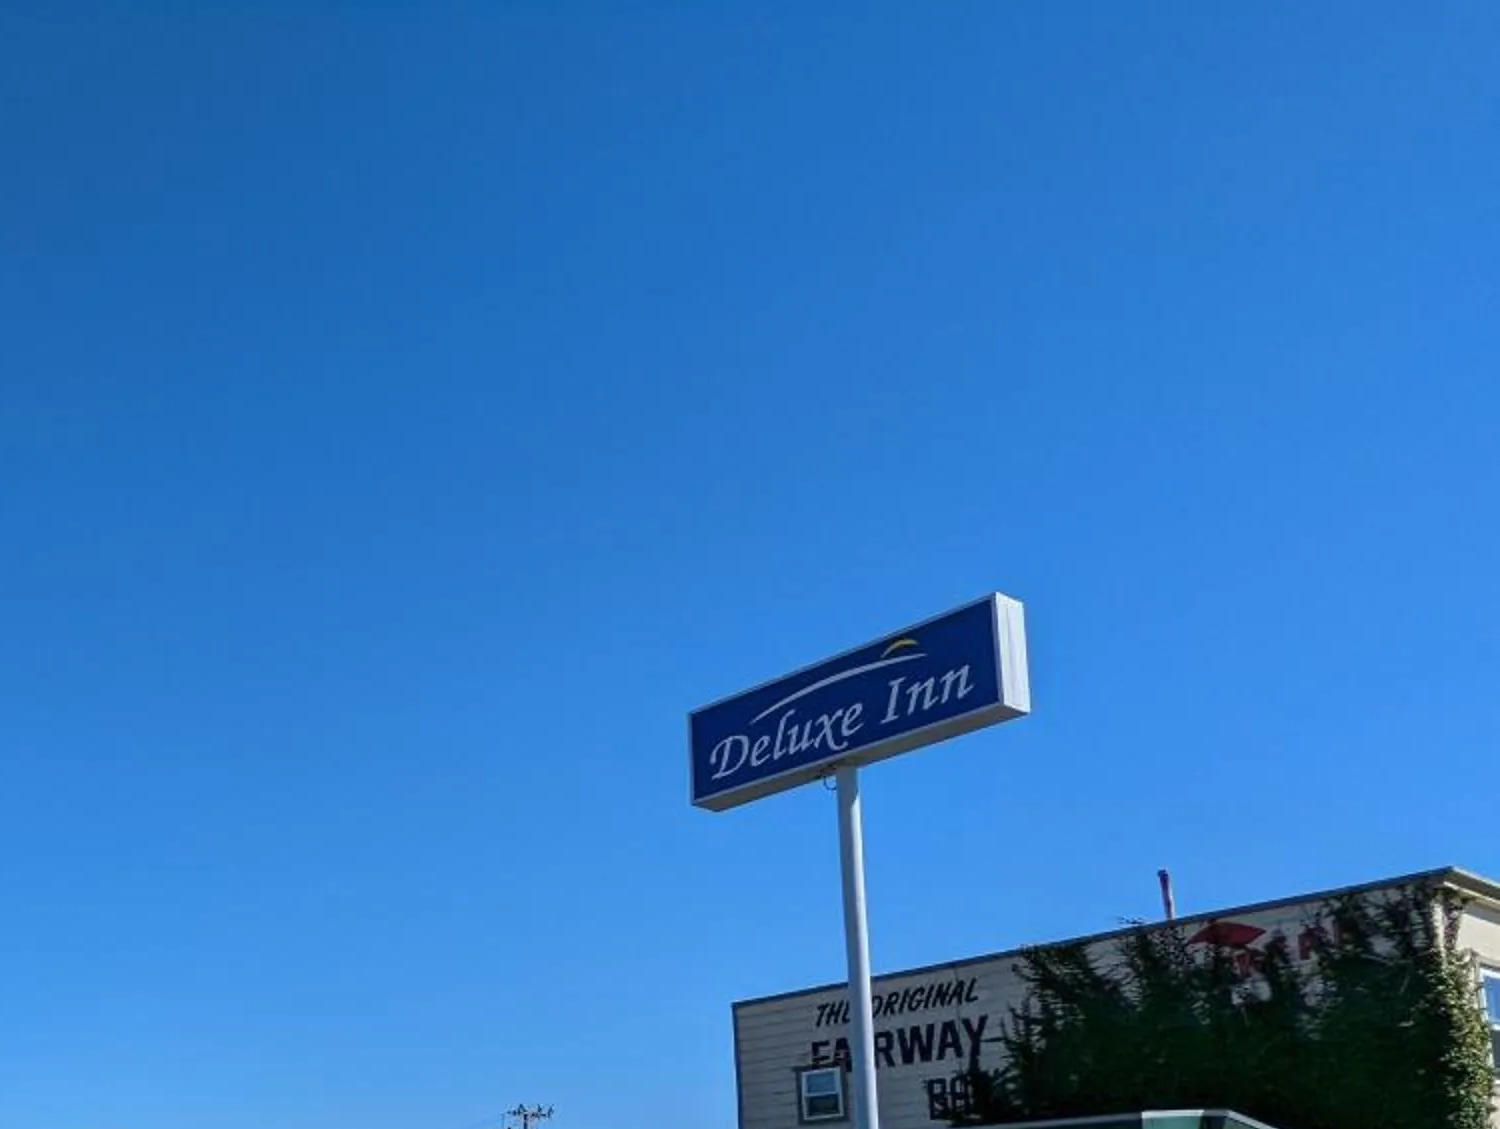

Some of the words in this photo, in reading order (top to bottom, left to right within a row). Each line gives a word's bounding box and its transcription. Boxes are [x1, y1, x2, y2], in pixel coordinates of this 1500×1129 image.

[708, 702, 865, 781] Deluxe
[879, 663, 975, 725] Inn
[811, 1014, 989, 1074] FARWAY
